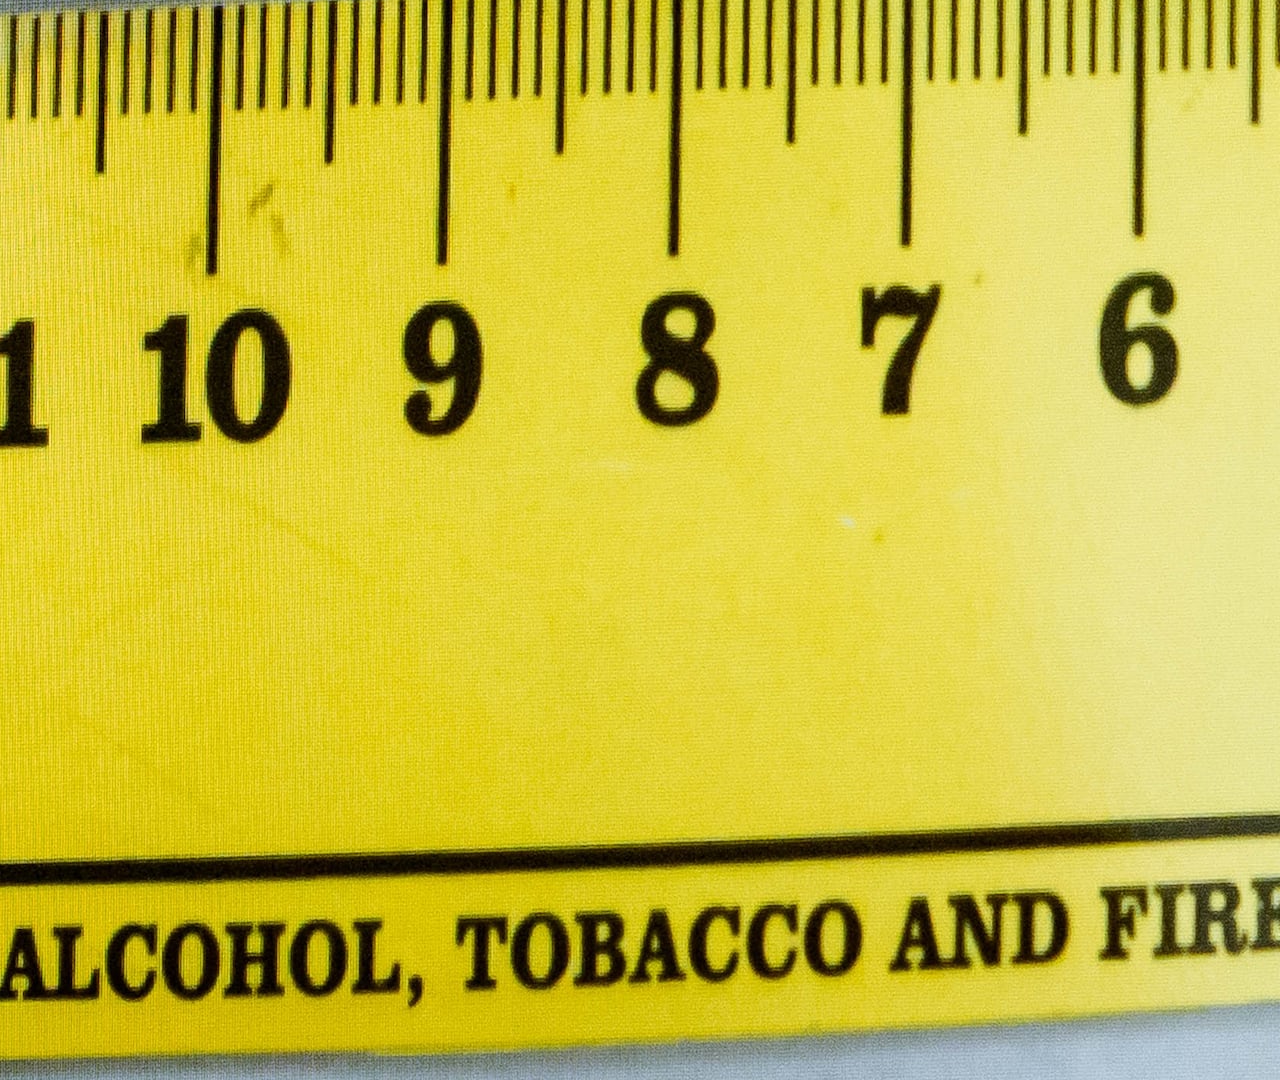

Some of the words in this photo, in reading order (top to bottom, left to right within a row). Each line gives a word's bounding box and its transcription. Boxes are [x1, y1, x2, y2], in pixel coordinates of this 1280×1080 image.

[140, 306, 293, 445] 10
[402, 299, 485, 438] 9
[634, 289, 721, 429] 8
[859, 283, 942, 417] 7
[1097, 271, 1180, 408] 6
[454, 898, 864, 993] TOBACCO
[888, 890, 1071, 974] AND
